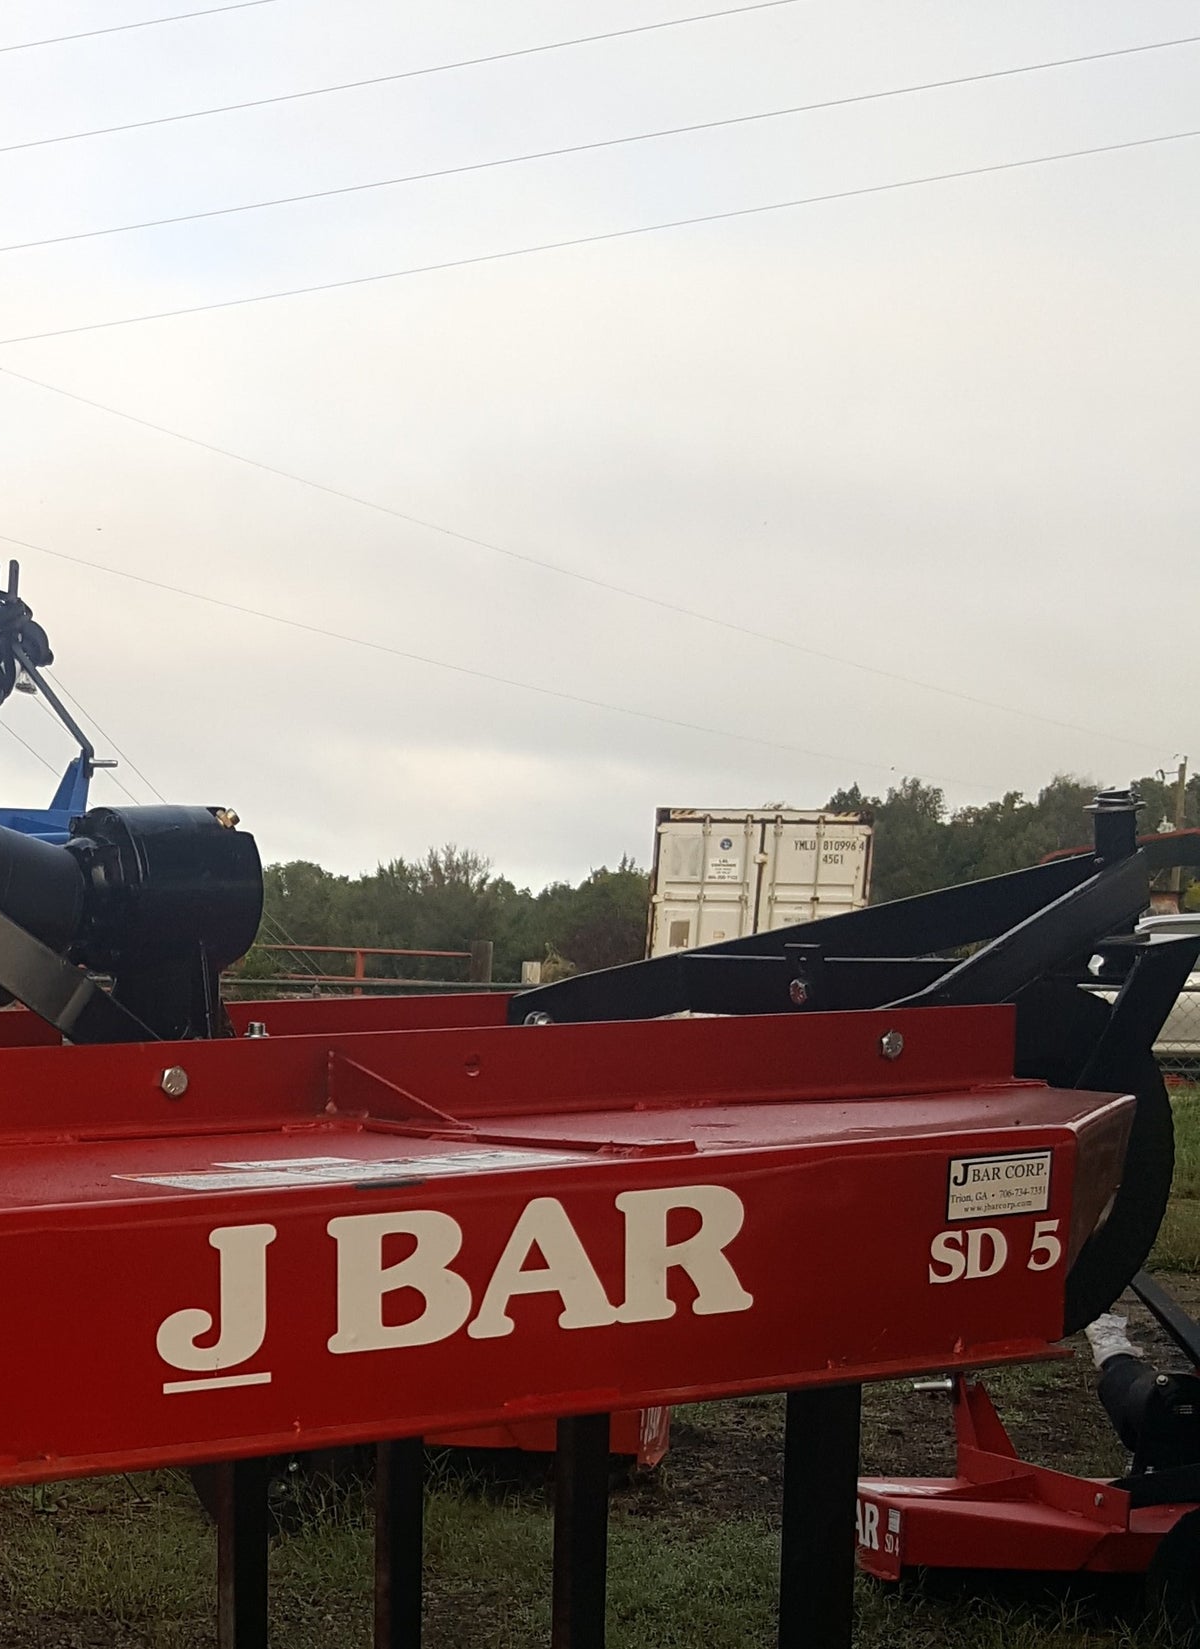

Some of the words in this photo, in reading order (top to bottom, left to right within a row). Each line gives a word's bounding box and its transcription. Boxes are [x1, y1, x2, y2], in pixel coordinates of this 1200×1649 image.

[794, 840, 816, 851] YMLU
[823, 841, 856, 851] 810996
[822, 854, 844, 864] 45G1
[953, 1163, 969, 1187] J
[972, 1167, 1001, 1183] BAR
[1005, 1162, 1047, 1179] CORP.
[975, 1191, 988, 1201] GA
[964, 1200, 1032, 1213] www.jbarcorp.com
[928, 1227, 1008, 1284] SD
[1027, 1219, 1061, 1271] 5
[156, 1223, 277, 1372] J
[327, 1185, 754, 1355] BAR
